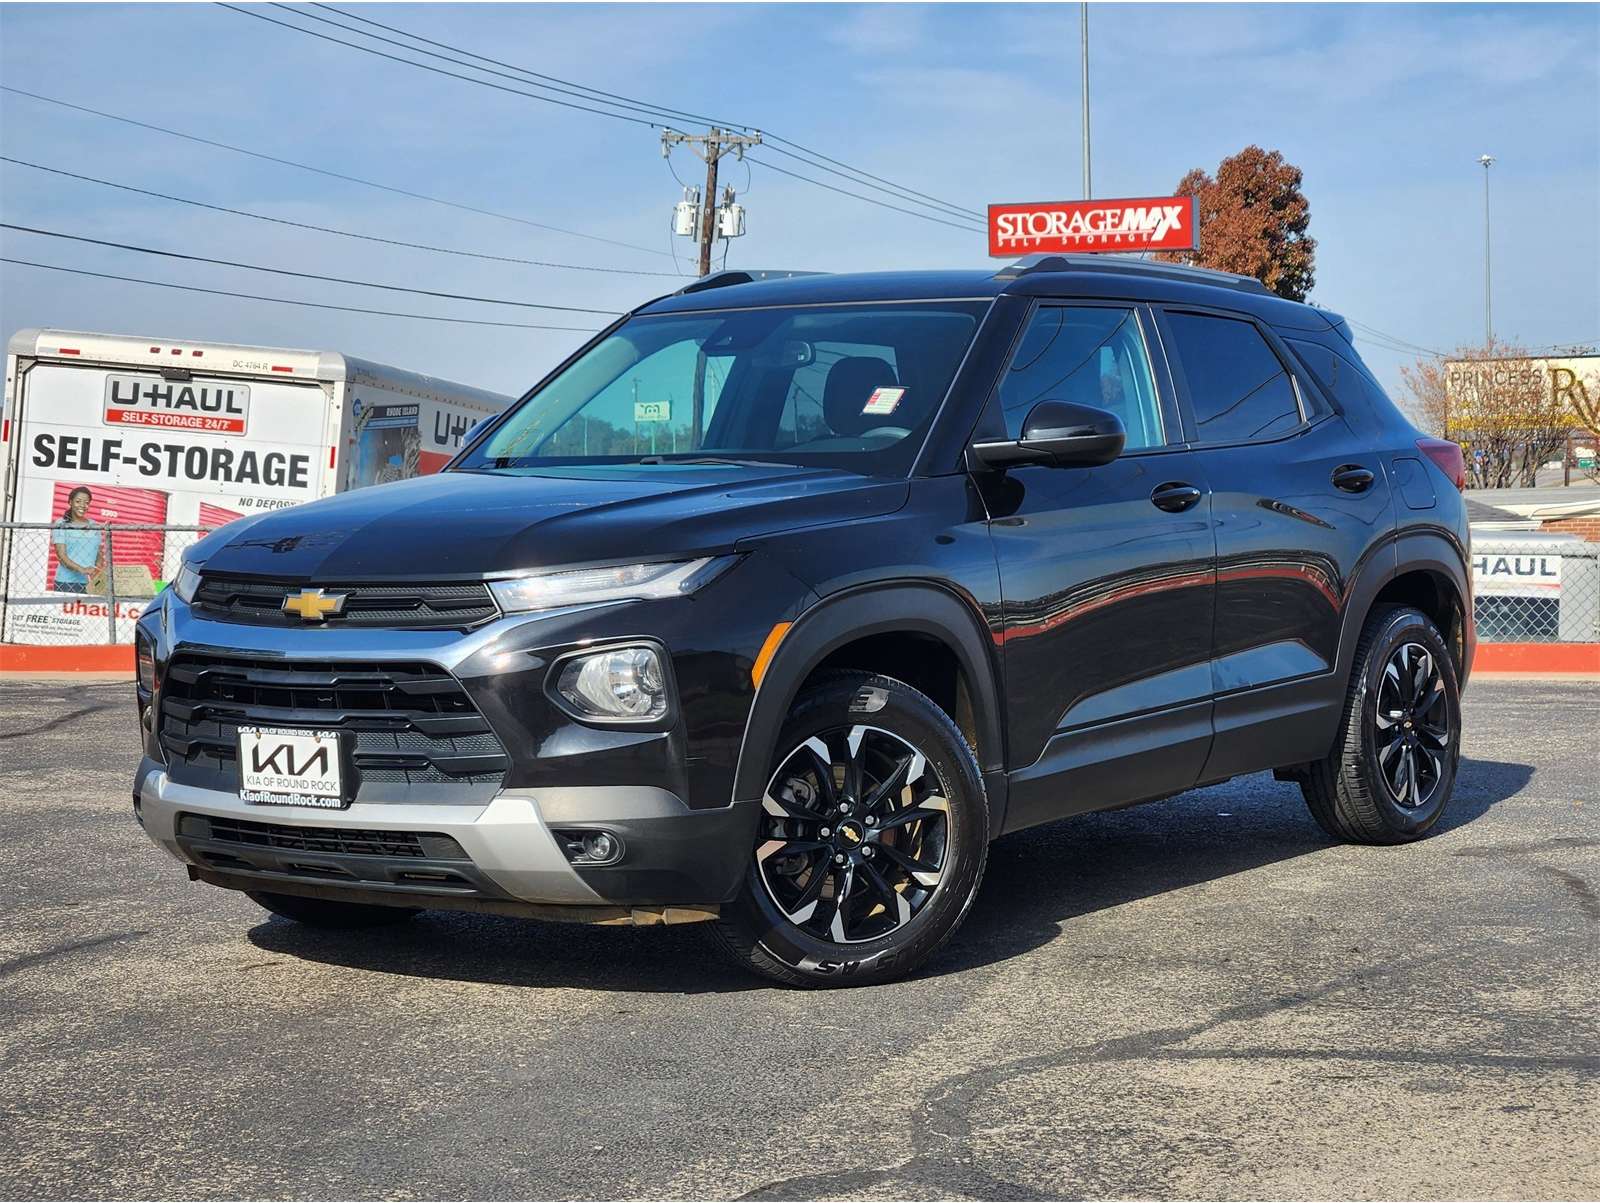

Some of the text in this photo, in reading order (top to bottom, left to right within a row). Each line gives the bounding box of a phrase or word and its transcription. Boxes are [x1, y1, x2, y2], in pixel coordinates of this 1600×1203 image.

[997, 206, 1183, 242] STORAGEMAX
[1062, 232, 1148, 245] STORAGE
[111, 380, 243, 414] U-HAUL
[122, 411, 203, 428] SELF-STORAGE
[32, 433, 310, 489] SELF-STORAGE
[239, 497, 254, 507] NO
[246, 775, 337, 791] KIA OF ROUND ROCK
[239, 789, 341, 808] KiaofRoundRock.com
